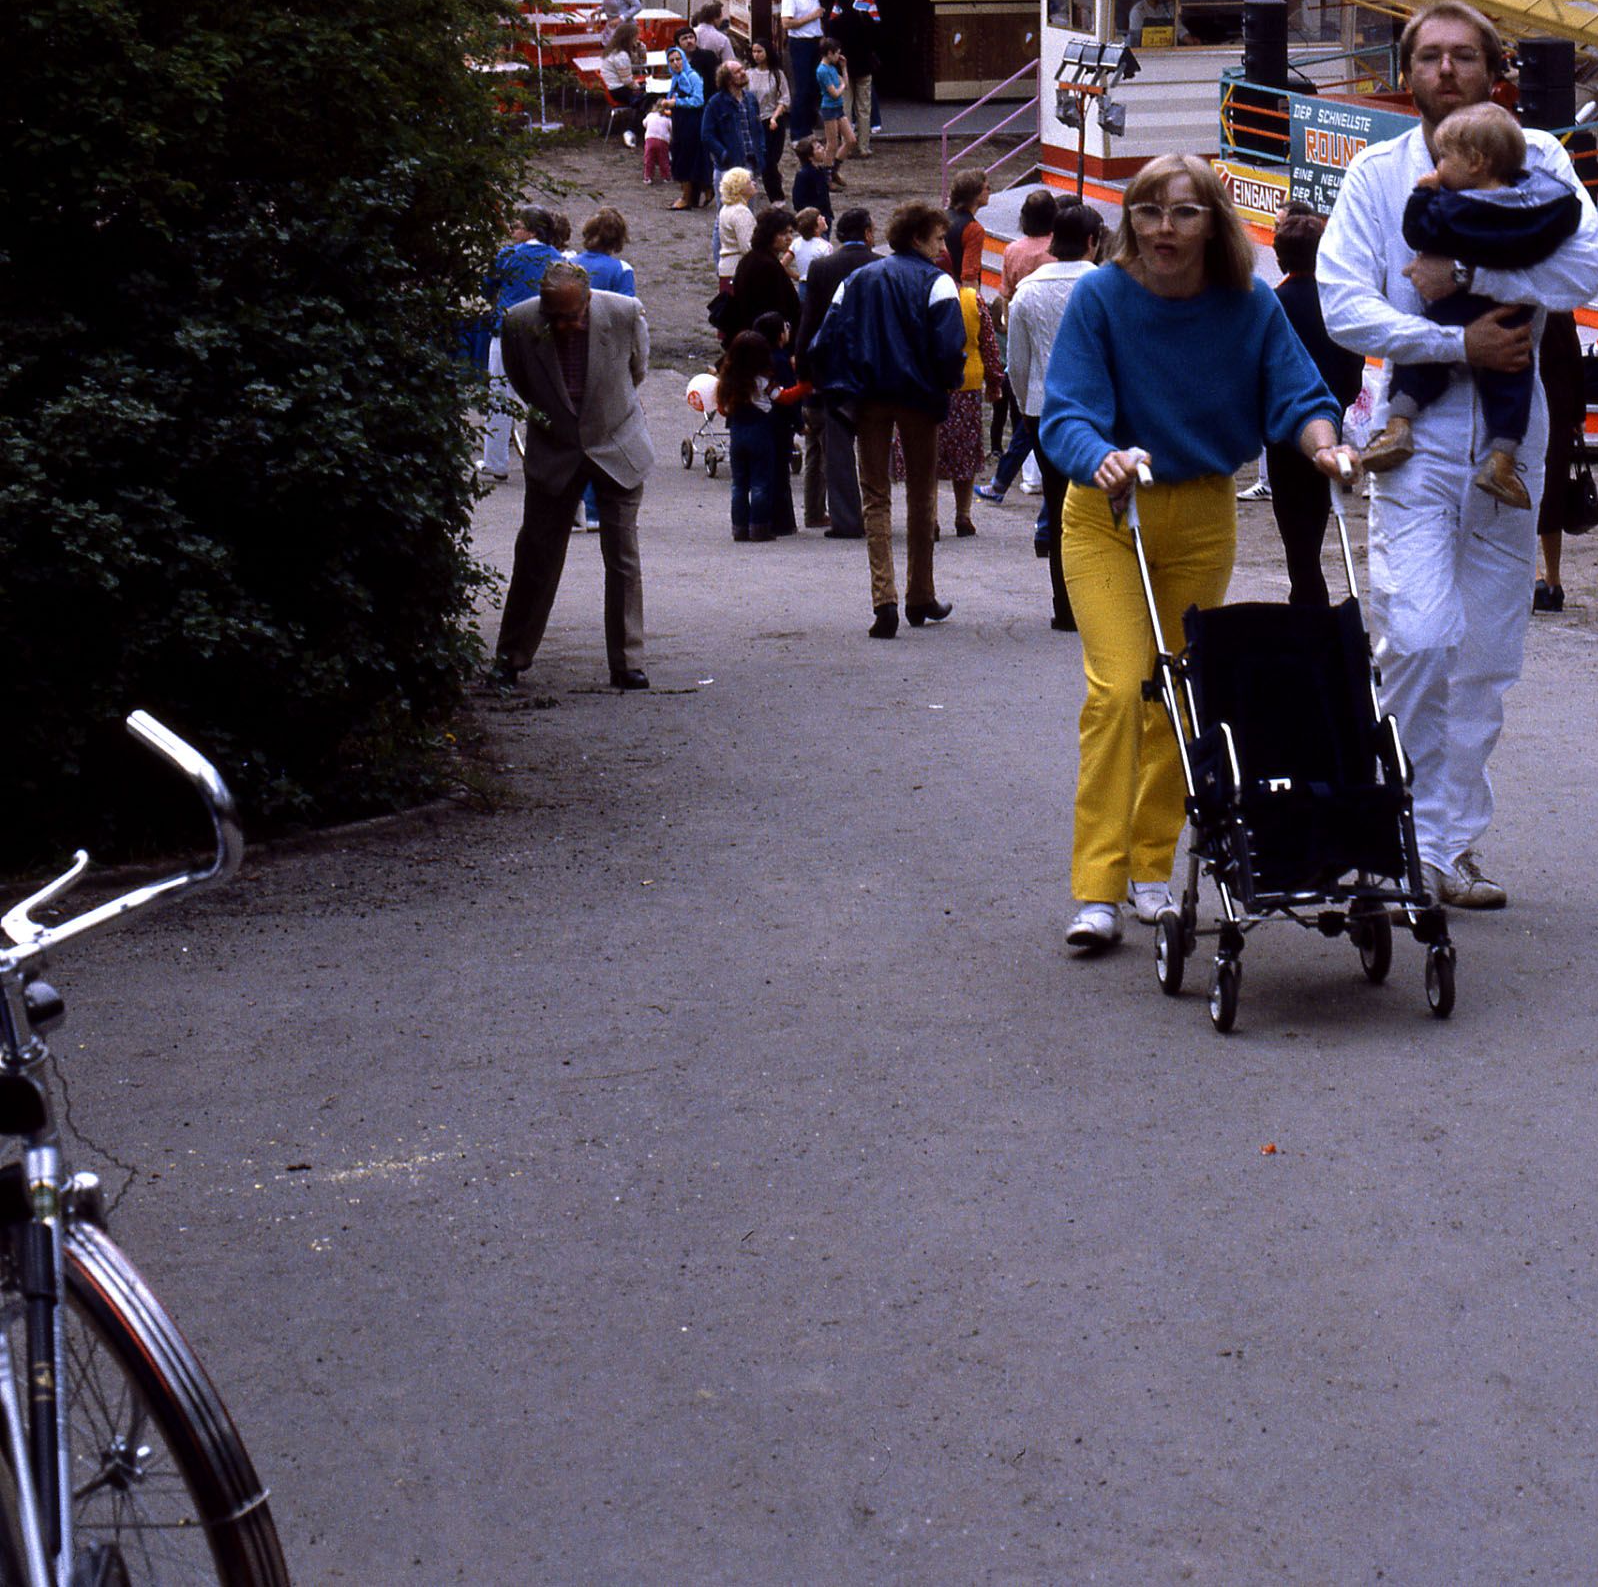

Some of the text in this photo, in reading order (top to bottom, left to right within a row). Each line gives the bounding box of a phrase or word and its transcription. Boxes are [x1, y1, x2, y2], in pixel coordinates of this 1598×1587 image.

[1293, 104, 1373, 133] DER SCHNELLSTE
[1293, 167, 1314, 182] EINE
[1233, 179, 1282, 213] EINGANG
[1292, 185, 1311, 199] DER
